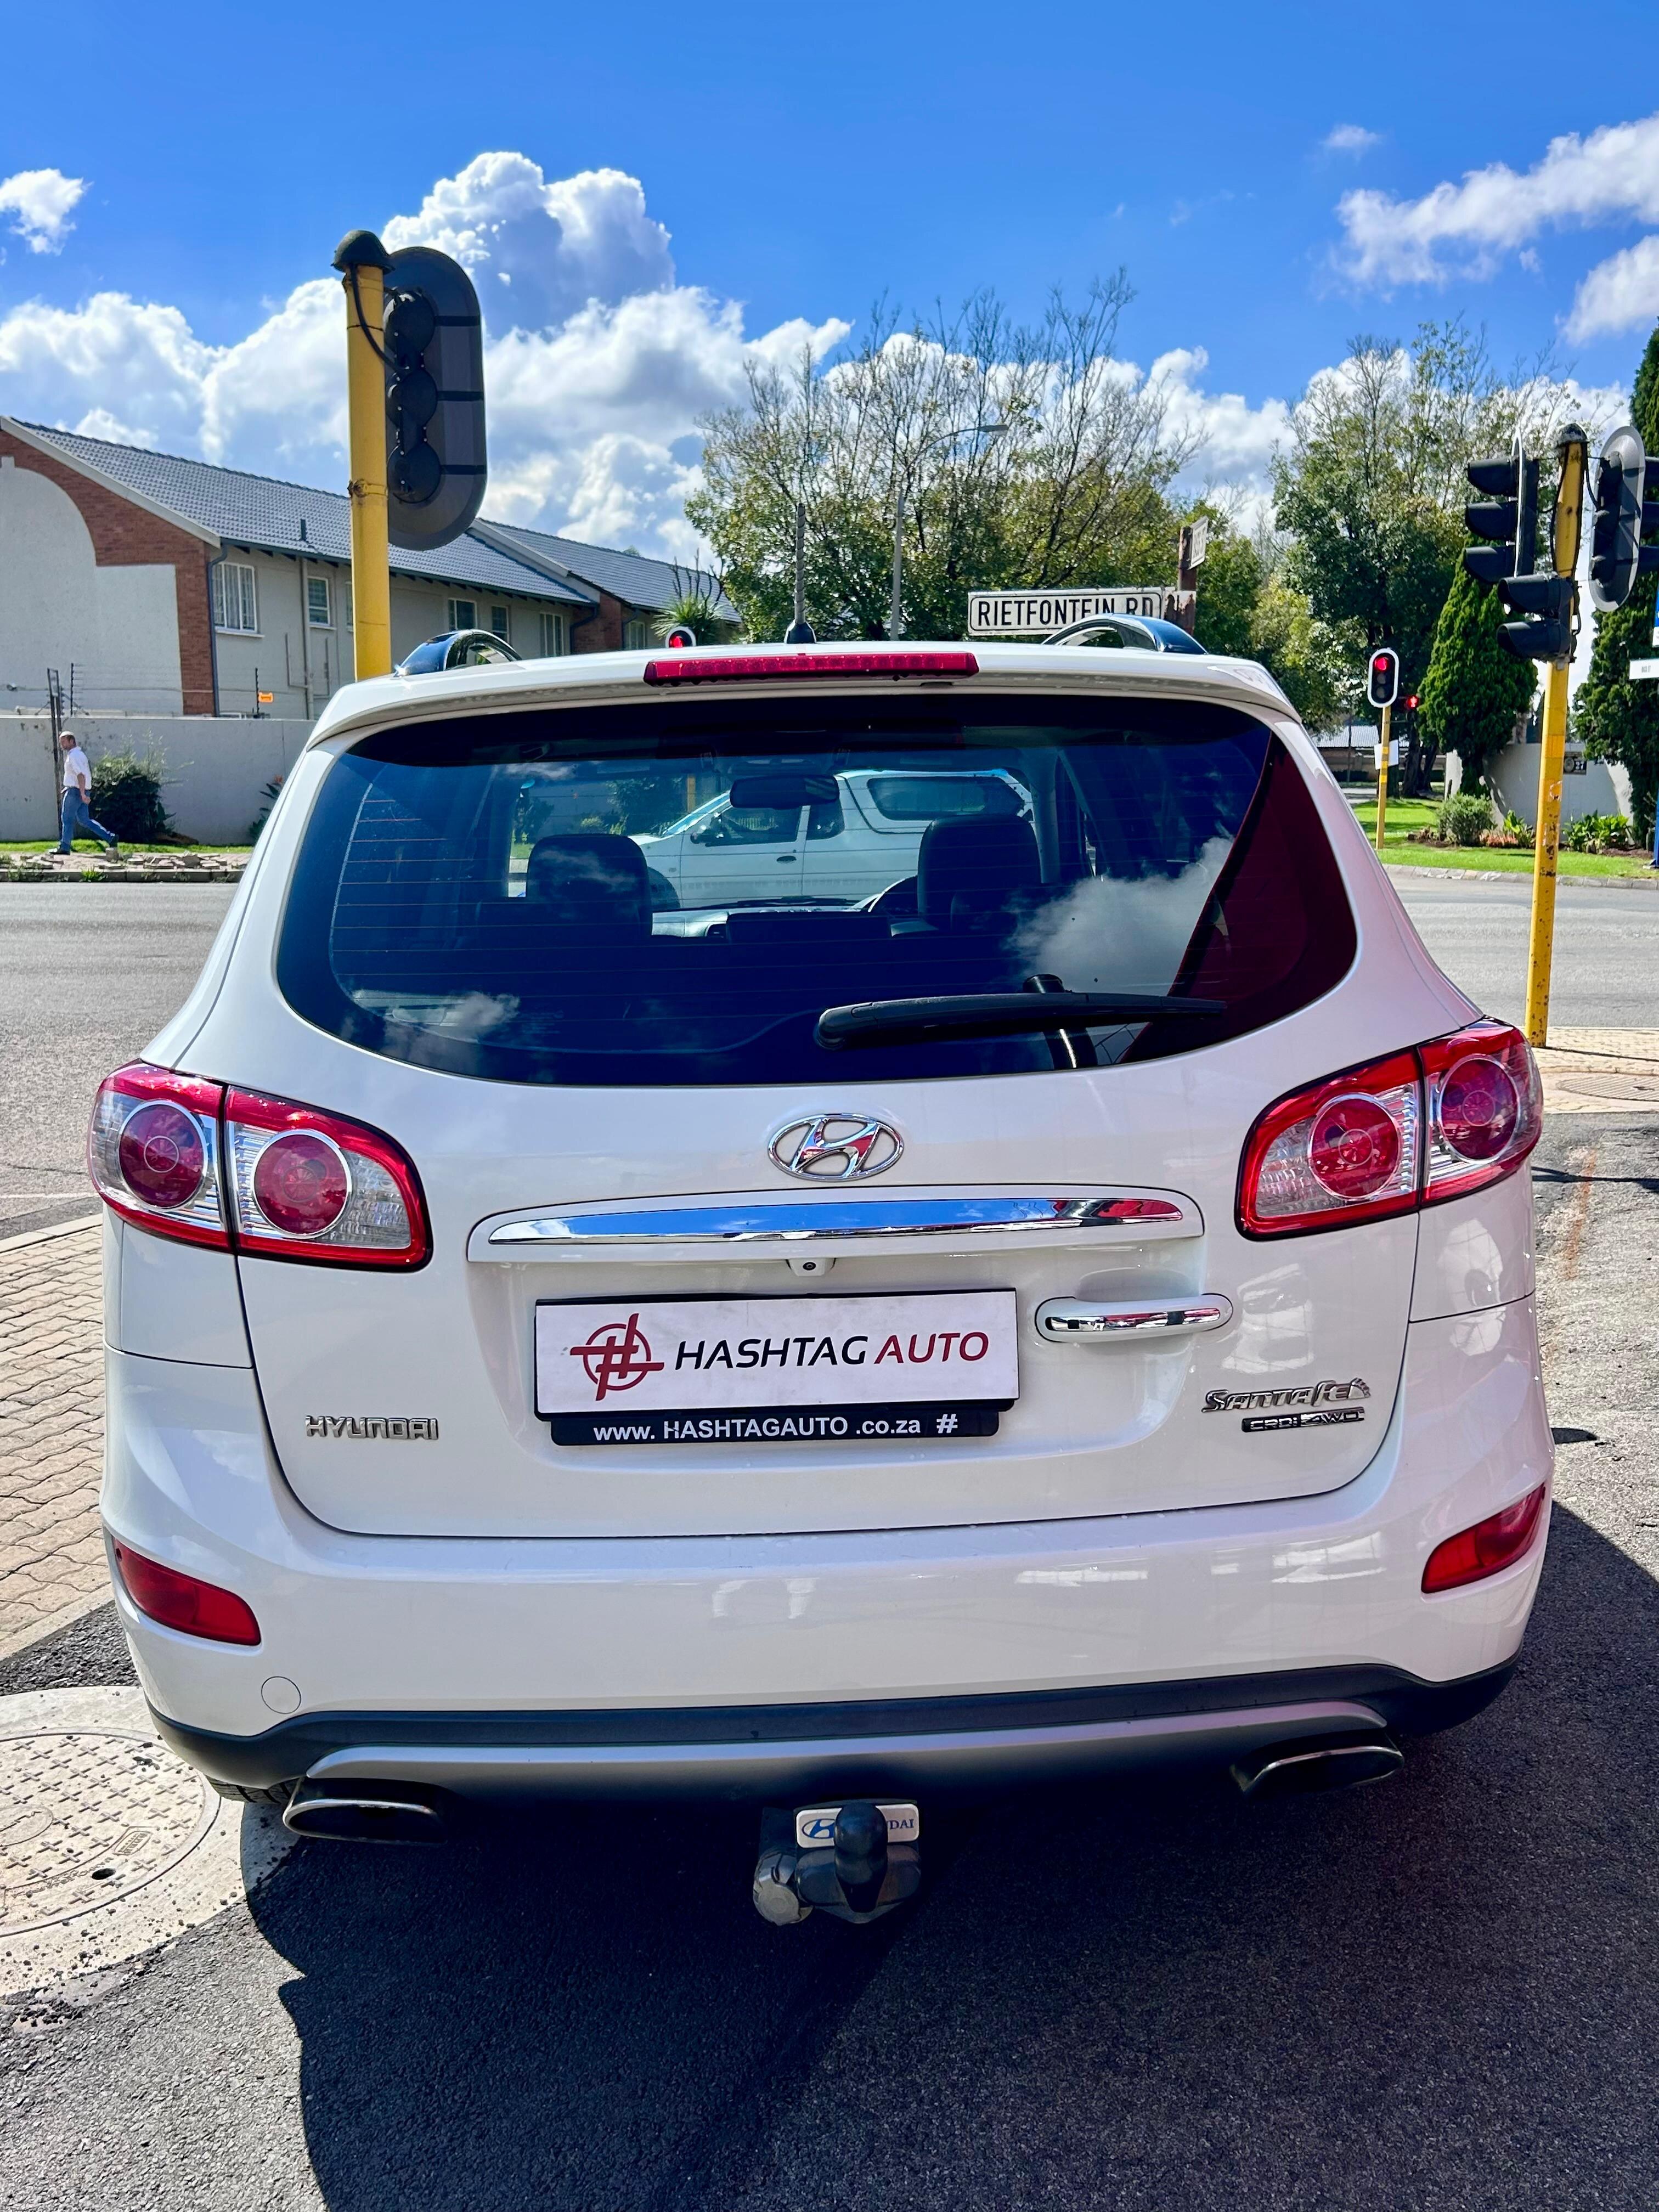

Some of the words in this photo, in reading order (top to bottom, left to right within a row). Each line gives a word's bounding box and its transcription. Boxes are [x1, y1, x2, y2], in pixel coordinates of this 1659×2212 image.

[978, 597, 1115, 627] RIETFONTEIN
[1126, 597, 1153, 617] RD
[675, 1335, 869, 1370] HASHTAG
[873, 1331, 990, 1364] AUTO
[305, 1415, 438, 1441] HYUNDAI
[594, 1425, 655, 1441] www.
[663, 1417, 848, 1440] HASHTAGAUTO
[856, 1419, 921, 1435] .co.za
[1302, 1410, 1360, 1425] 4WD
